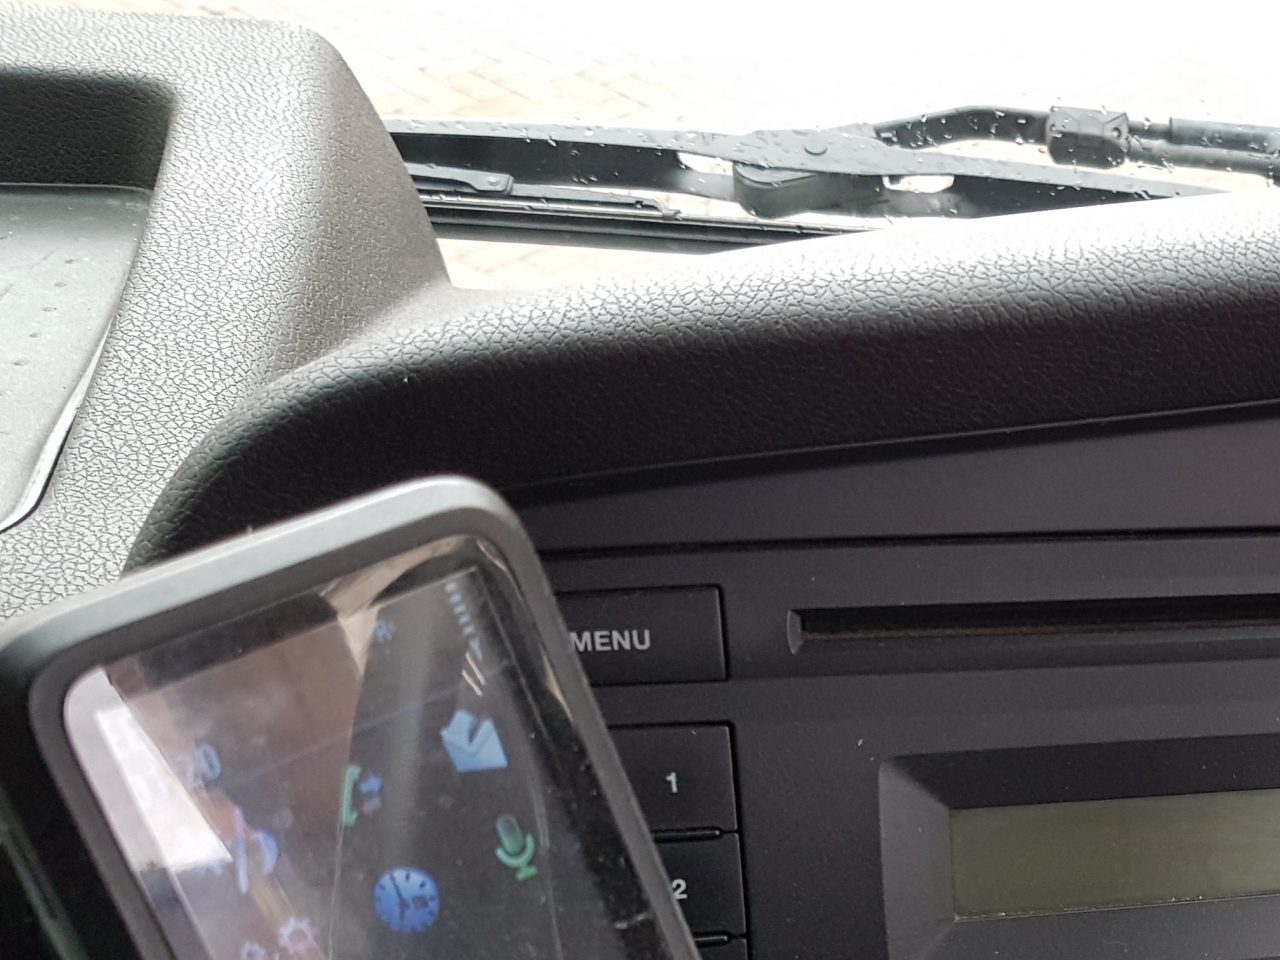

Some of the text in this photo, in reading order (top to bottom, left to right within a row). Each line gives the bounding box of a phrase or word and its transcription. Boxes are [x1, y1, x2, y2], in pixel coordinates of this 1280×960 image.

[569, 629, 651, 652] MENU
[665, 772, 678, 793] 1
[671, 879, 688, 900] 2
